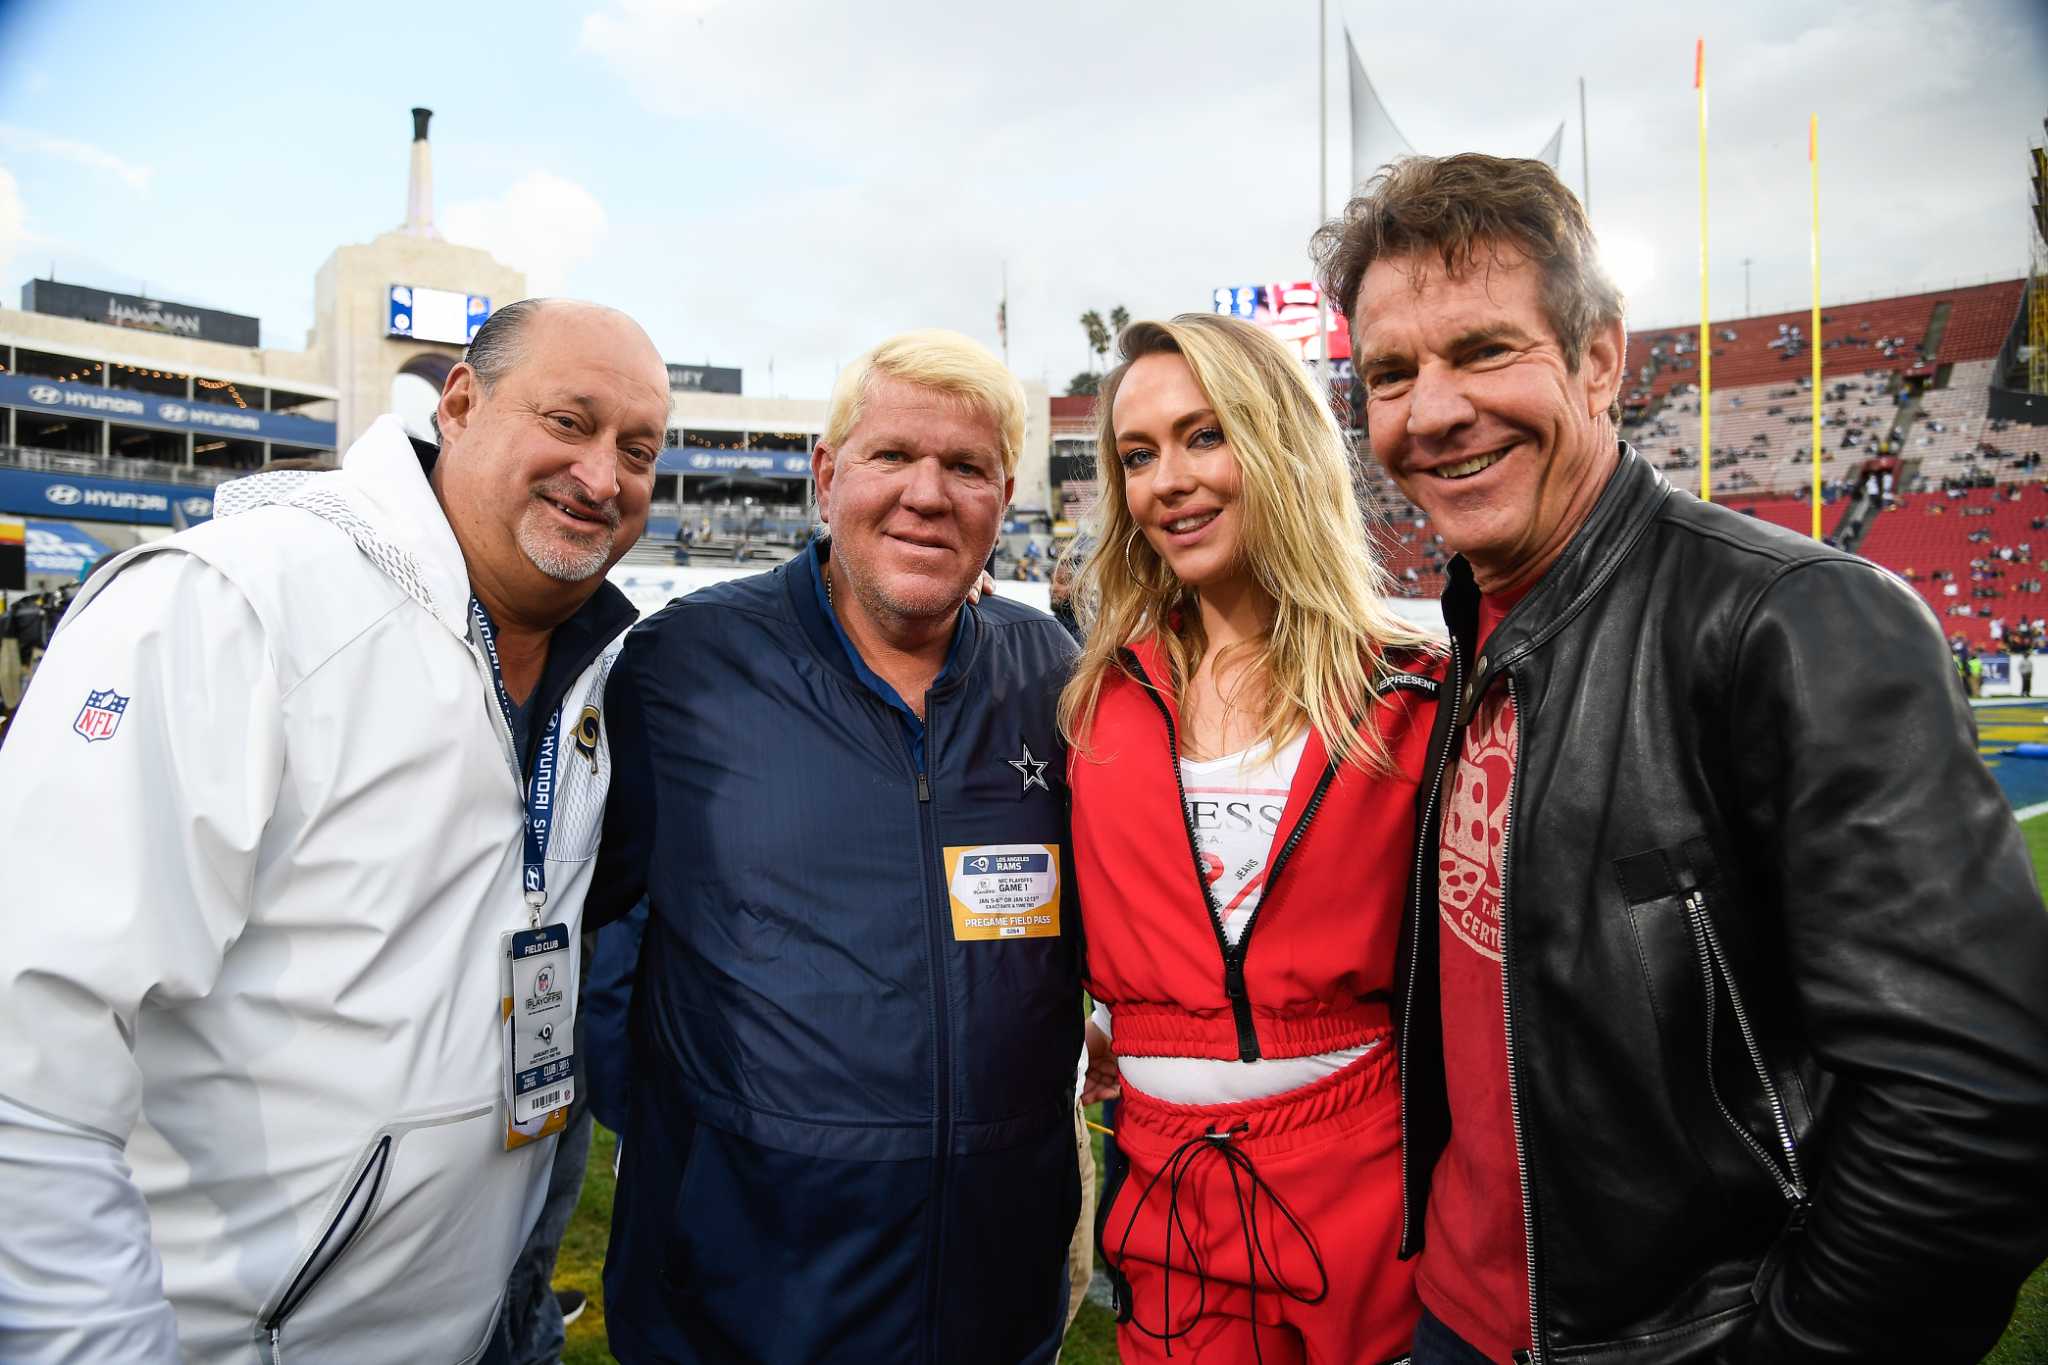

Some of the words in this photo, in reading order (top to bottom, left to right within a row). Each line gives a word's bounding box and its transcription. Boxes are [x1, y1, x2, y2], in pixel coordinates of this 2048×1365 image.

[65, 391, 145, 415] HYUNDAI
[190, 410, 260, 431] HYUNDAI
[84, 490, 168, 511] HYUNDAI
[78, 708, 114, 737] NFL
[535, 735, 555, 811] HYUNDAI
[997, 862, 1022, 871] RAMS
[1234, 858, 1259, 881] JEANS
[999, 884, 1023, 892] GAME
[965, 918, 1009, 928] PREGAME
[1010, 916, 1033, 926] FIELD
[1033, 915, 1051, 925] PASS
[525, 943, 543, 955] FIELD
[542, 940, 559, 951] CLUB
